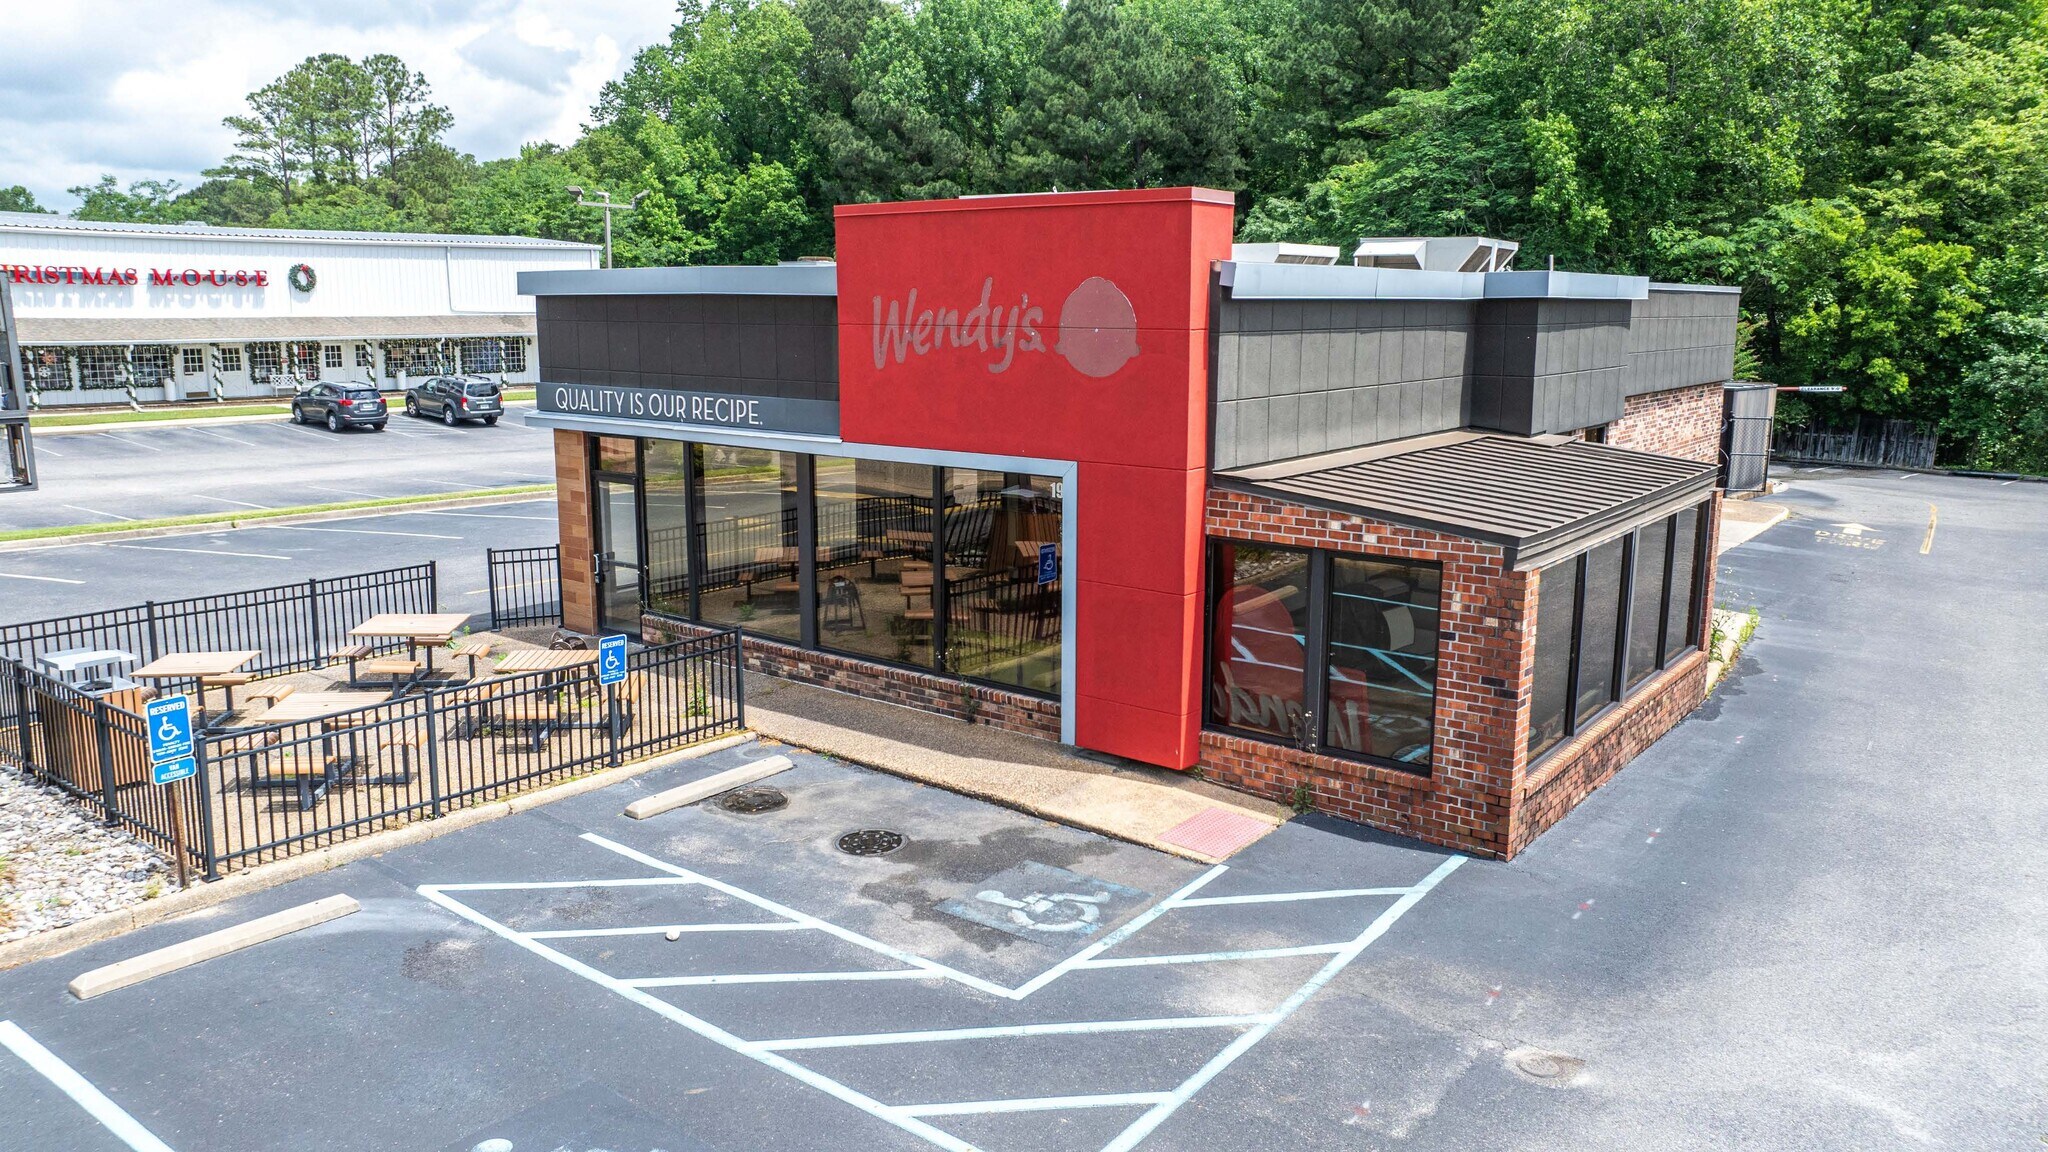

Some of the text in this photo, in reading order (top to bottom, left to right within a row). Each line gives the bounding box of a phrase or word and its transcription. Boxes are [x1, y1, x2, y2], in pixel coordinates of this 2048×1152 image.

[873, 277, 1046, 373] Wendy's
[555, 387, 763, 425] QUALITY IS OUR RECIPE.
[602, 639, 625, 650] RESERVED
[149, 701, 186, 716] RESERVED
